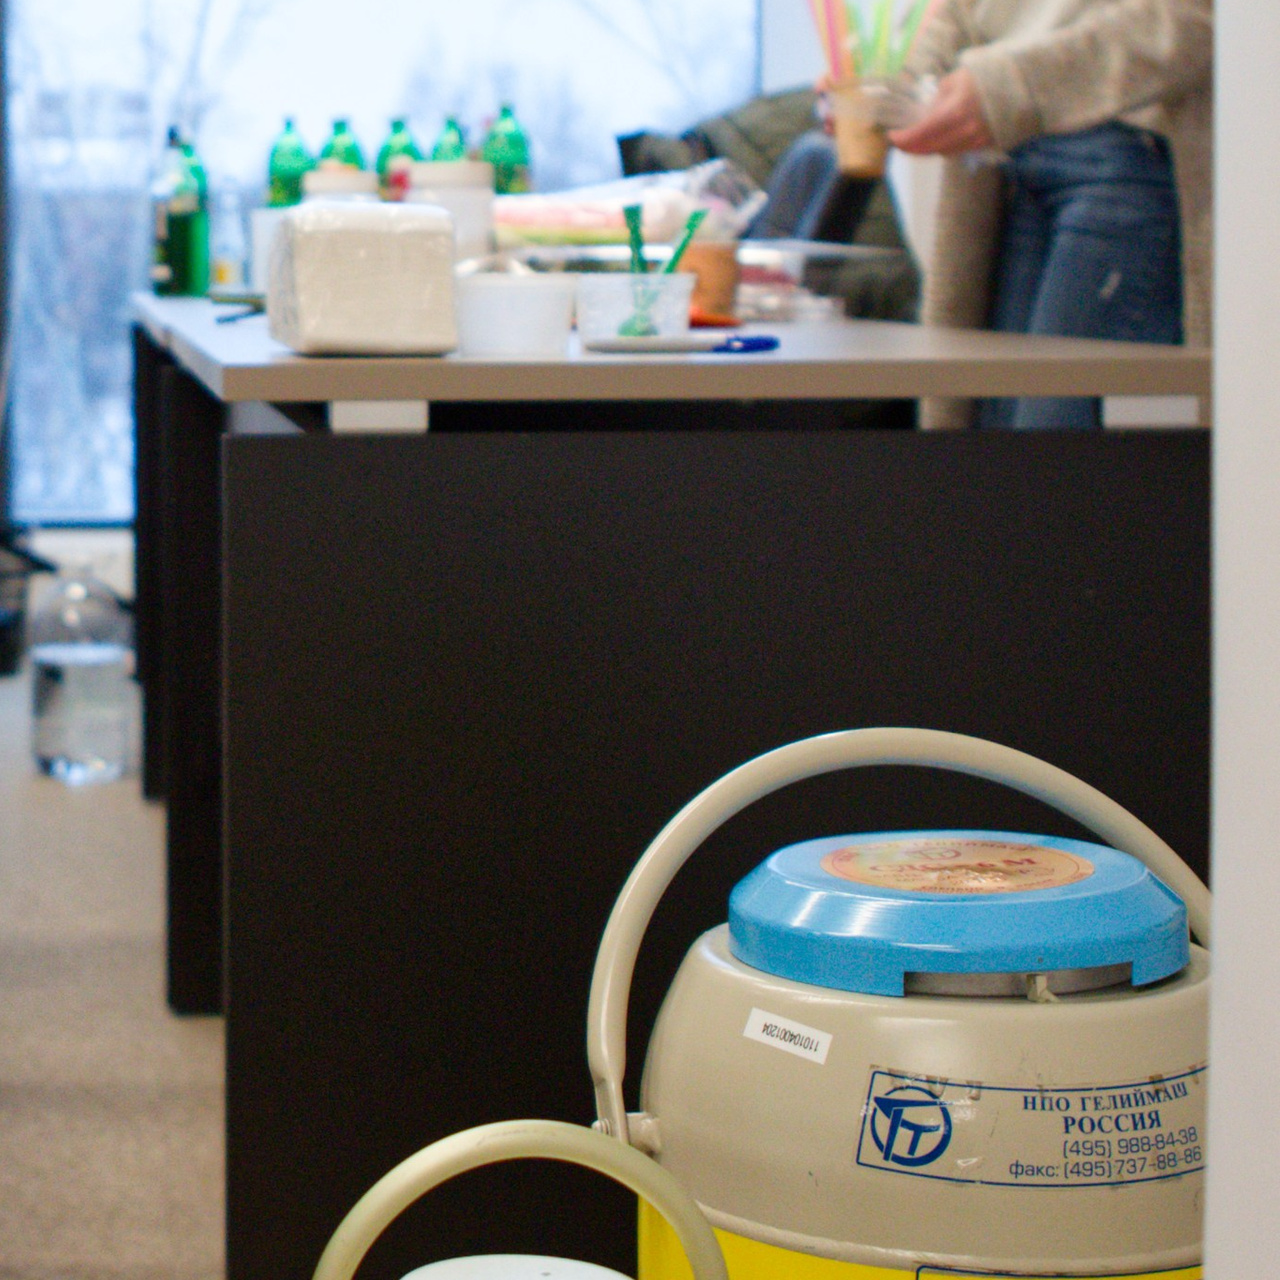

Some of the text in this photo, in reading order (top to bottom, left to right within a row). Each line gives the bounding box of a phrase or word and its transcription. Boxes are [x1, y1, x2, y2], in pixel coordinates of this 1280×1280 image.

[1023, 1082, 1188, 1112] НПО ГЕЛИЙМАШ
[1062, 1110, 1162, 1134] РОССИЯ
[1063, 1126, 1198, 1158] (495) 988-84-38
[1009, 1160, 1059, 1178] факс:
